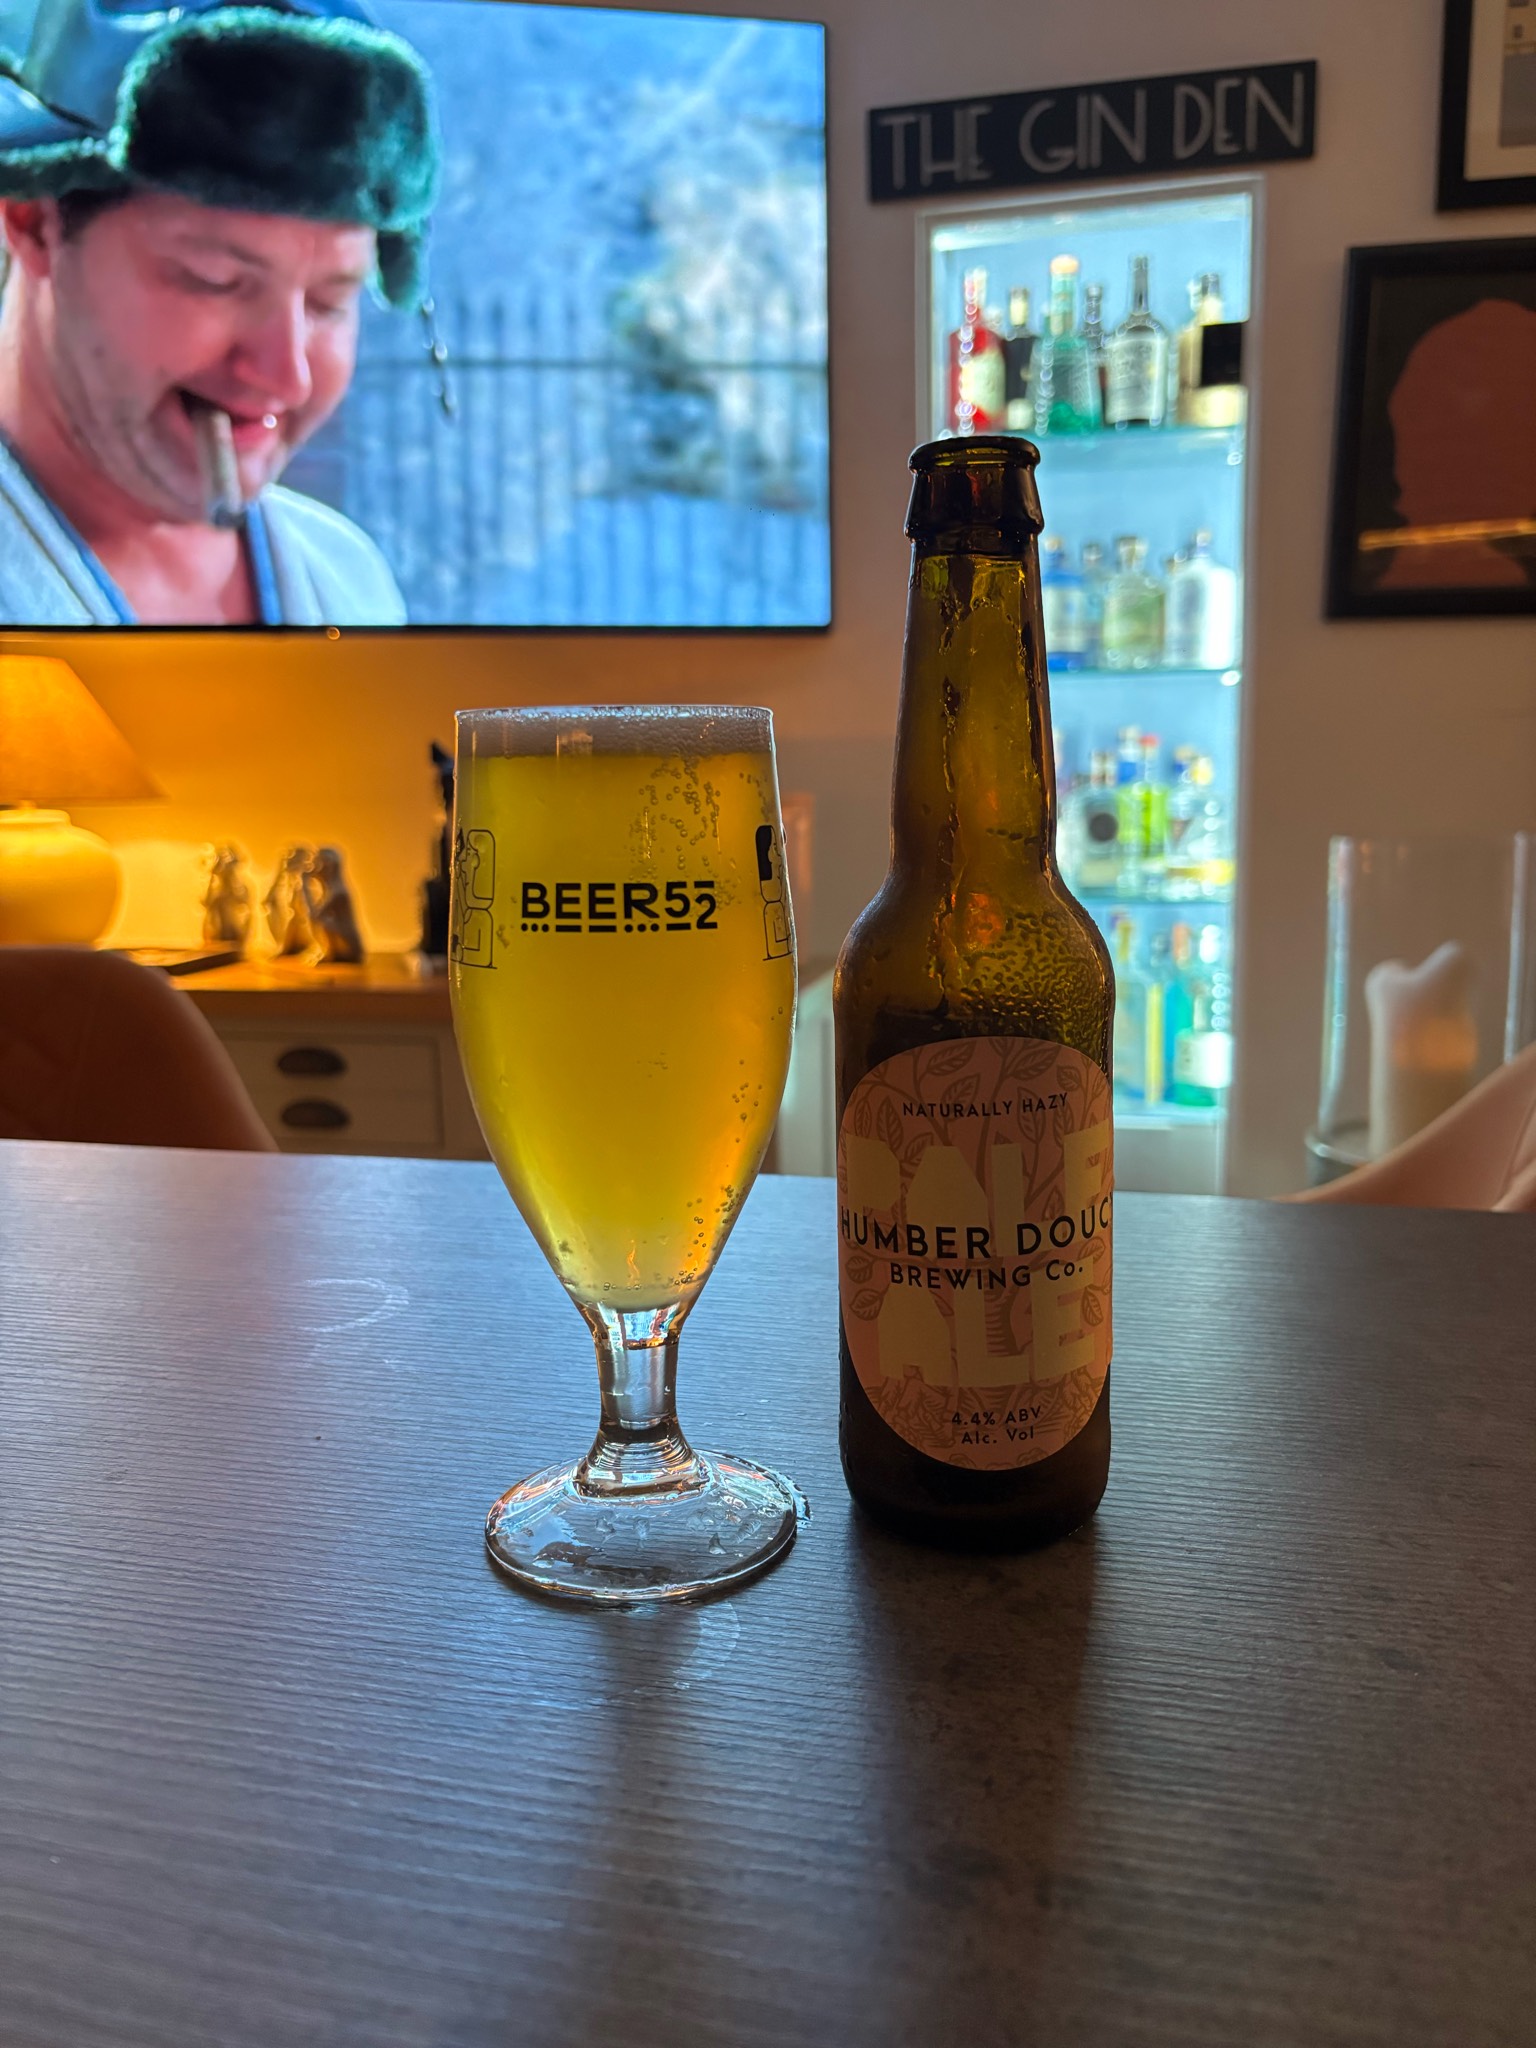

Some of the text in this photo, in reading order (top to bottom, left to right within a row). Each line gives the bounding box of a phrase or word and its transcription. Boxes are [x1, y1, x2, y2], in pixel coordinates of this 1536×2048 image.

[880, 70, 1305, 190] THE GIN DEN
[521, 880, 718, 930] BEER52
[902, 1092, 1069, 1119] NATURALLY HAZY
[841, 1205, 991, 1259] HUMBER
[890, 1258, 1084, 1290] BREWING Co.
[951, 1405, 1042, 1427] 4.4% ABV
[961, 1425, 1035, 1446] Alc. Vol
